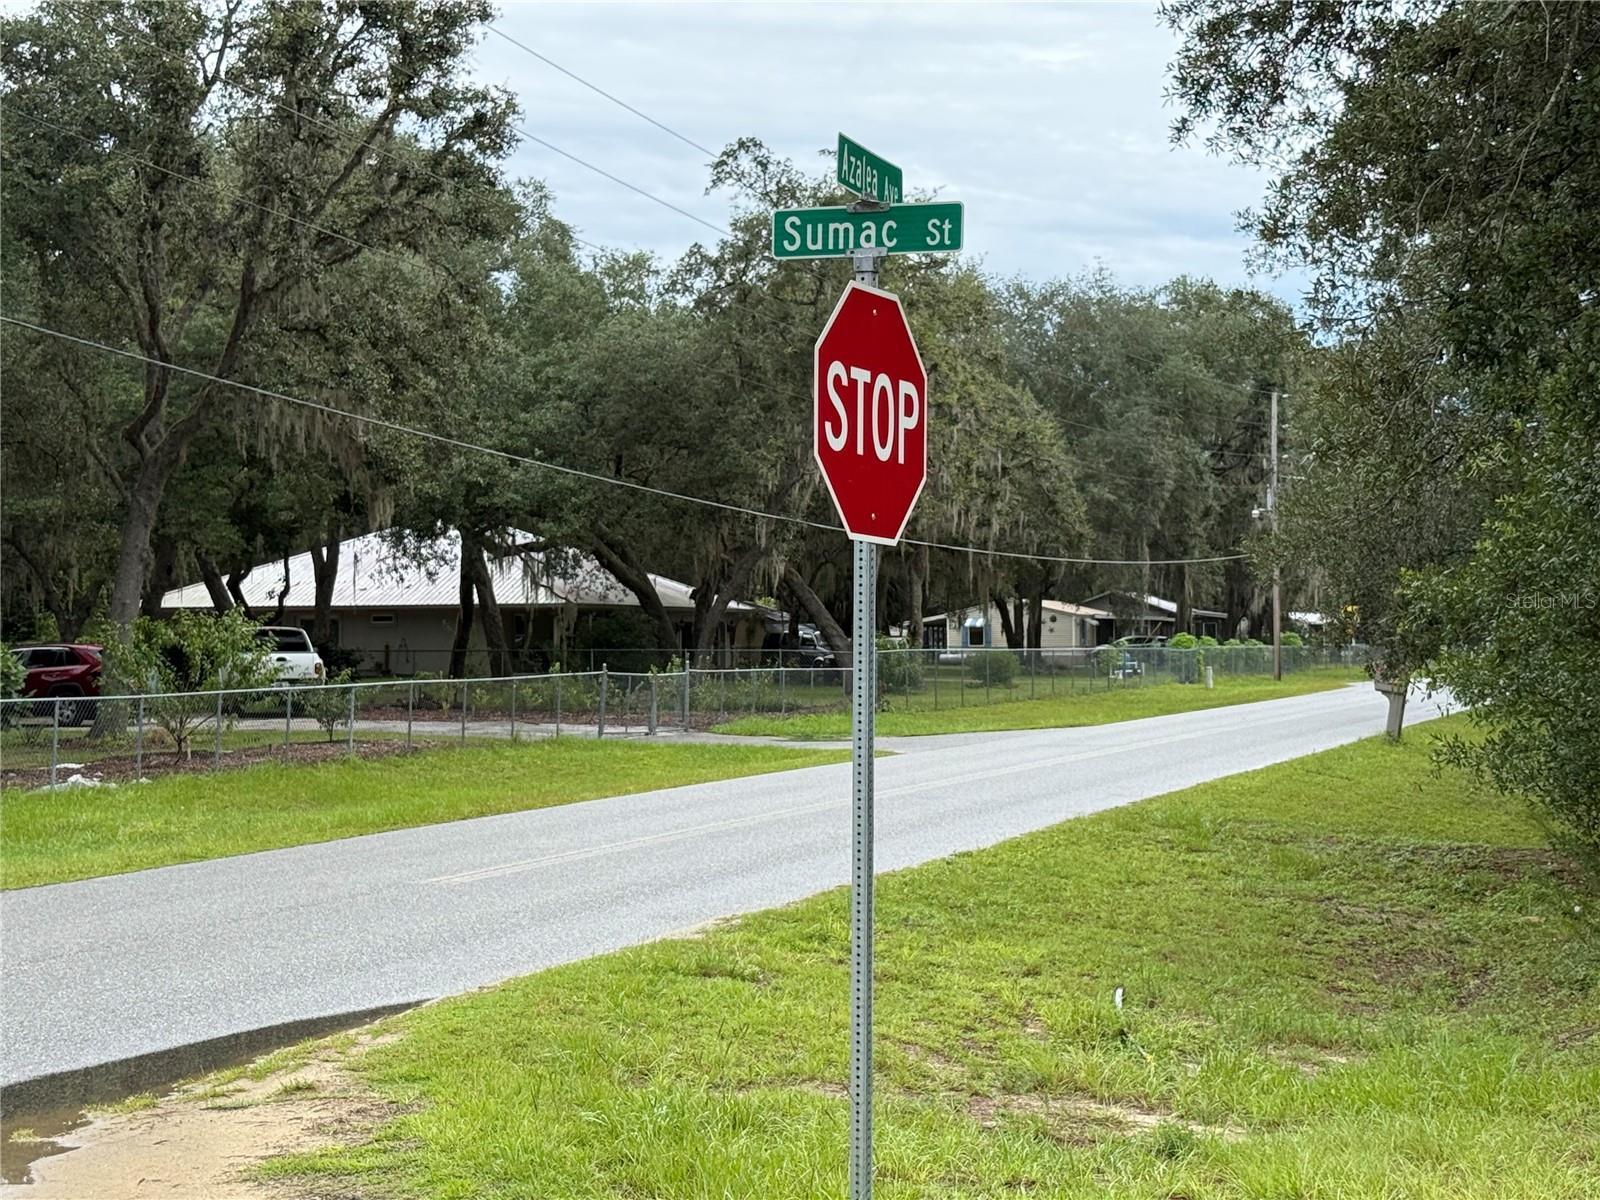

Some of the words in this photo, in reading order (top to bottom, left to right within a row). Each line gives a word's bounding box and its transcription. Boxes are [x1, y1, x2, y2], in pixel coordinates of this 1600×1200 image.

[841, 143, 878, 197] Azalea
[883, 175, 899, 204] Ave
[783, 215, 898, 251] Sumac
[925, 218, 952, 246] St
[824, 360, 920, 465] STOP
